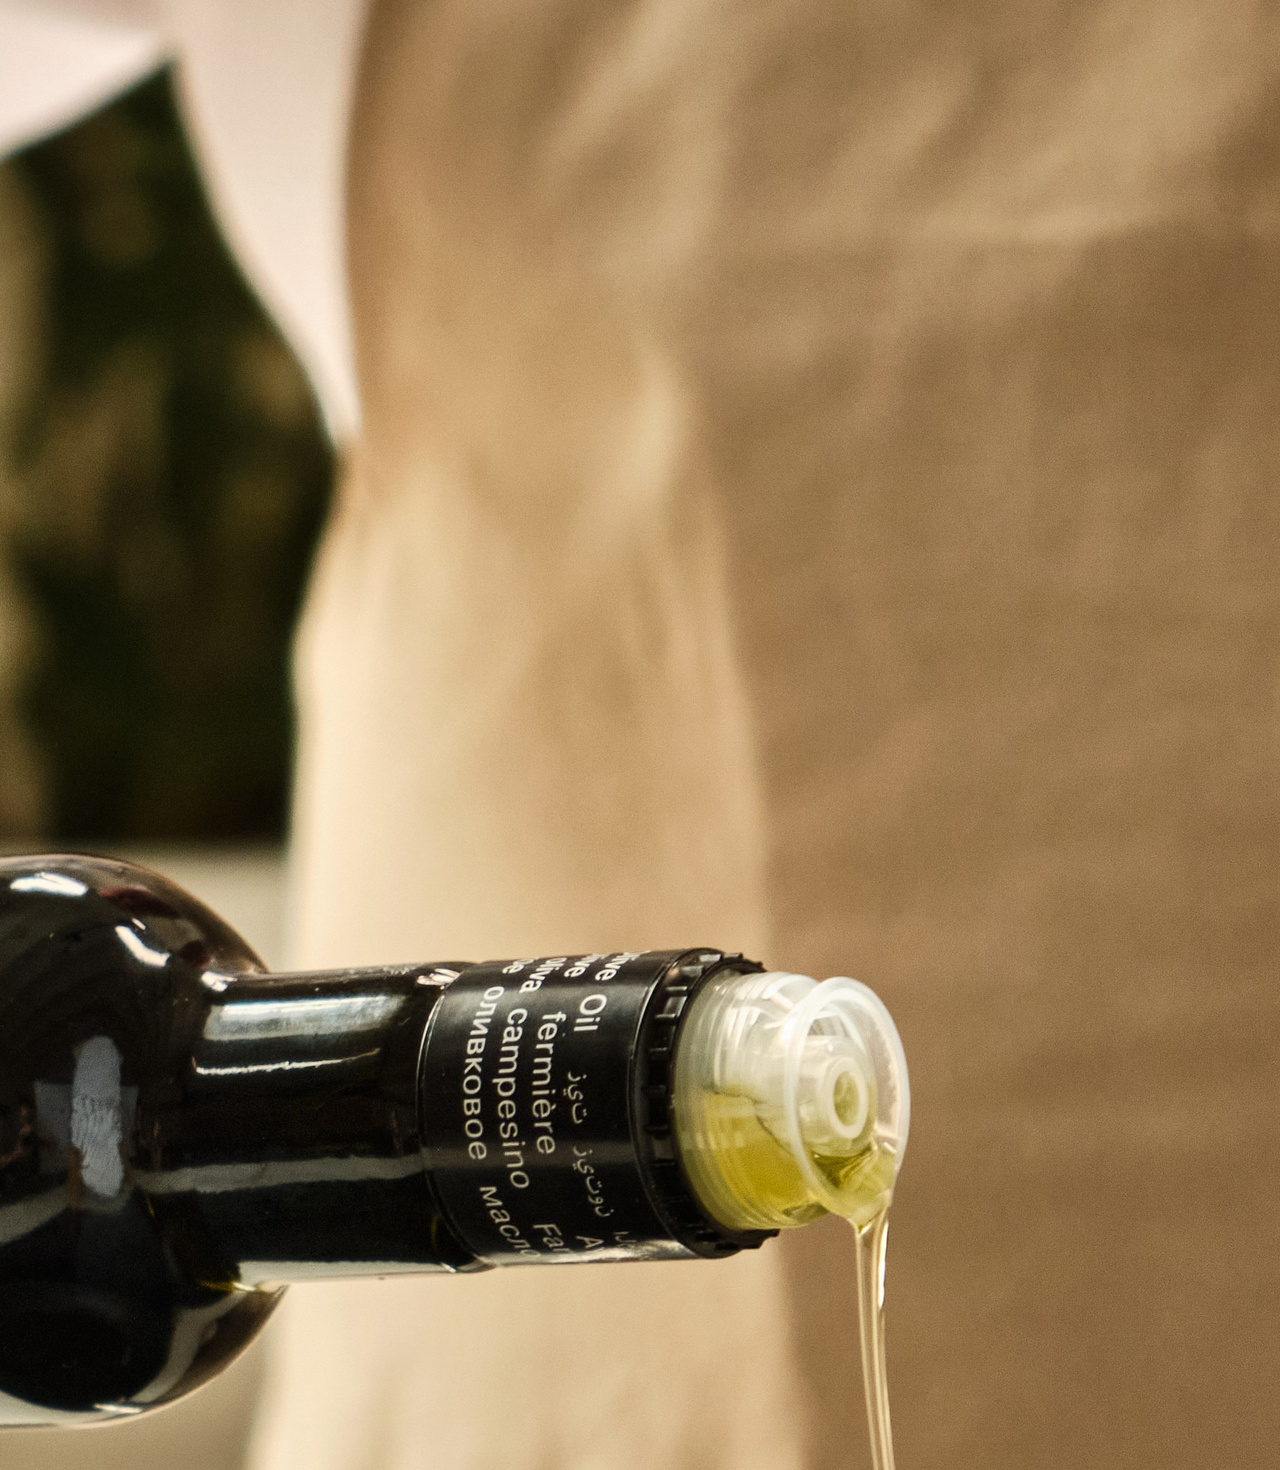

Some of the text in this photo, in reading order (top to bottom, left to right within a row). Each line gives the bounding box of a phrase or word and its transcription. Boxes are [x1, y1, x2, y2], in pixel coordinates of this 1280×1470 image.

[462, 985, 505, 1161] оливковое
[492, 956, 568, 1190] oliva campesino
[531, 1009, 567, 1155] fermière
[573, 993, 608, 1032] Oil
[479, 1185, 542, 1258] масло
